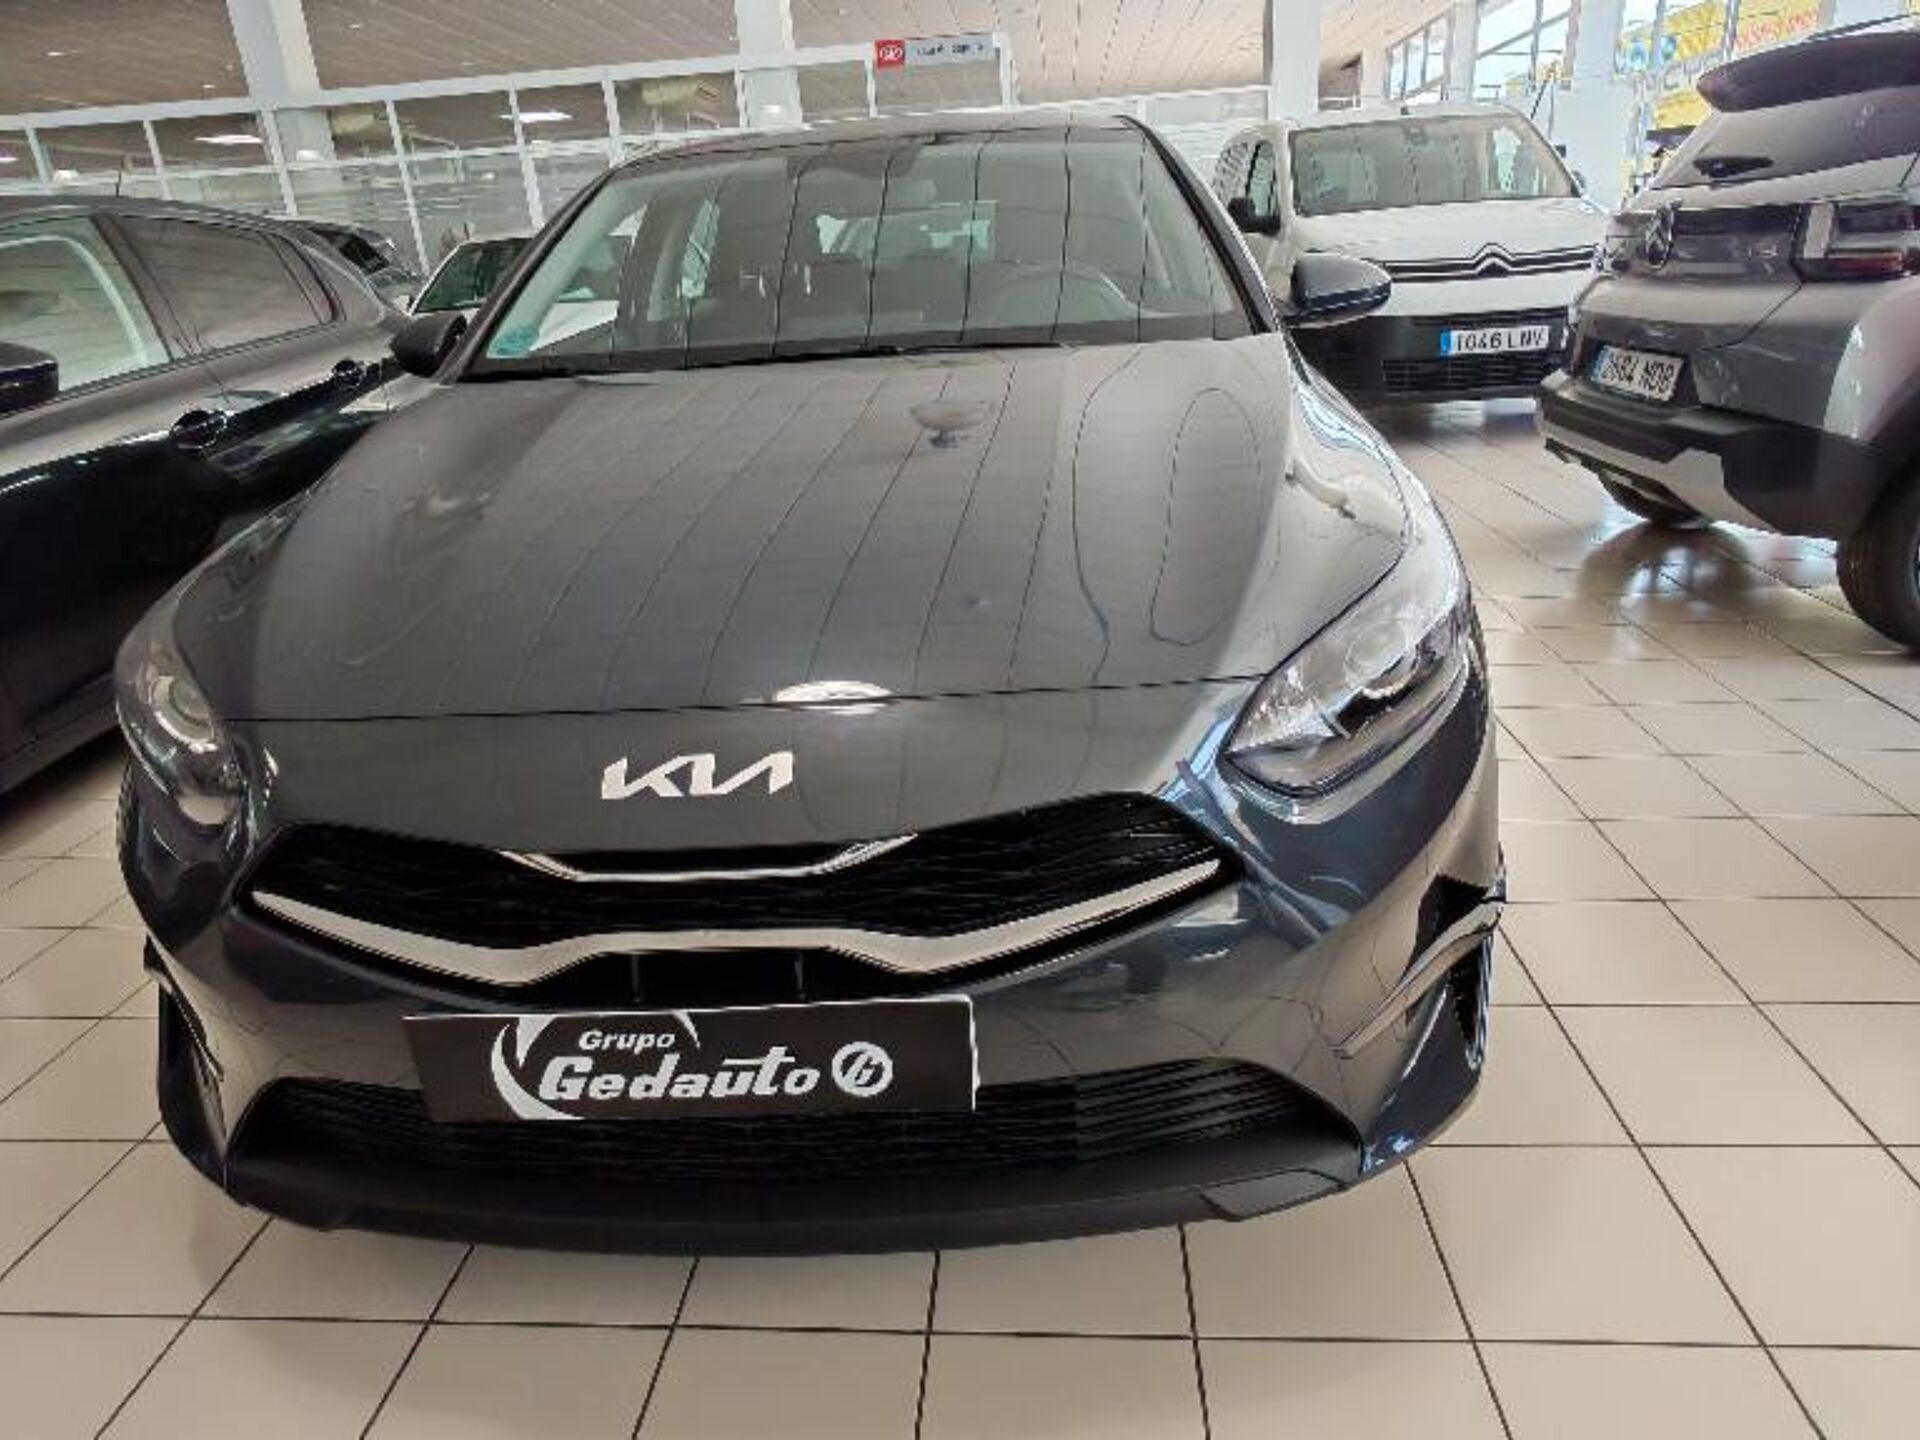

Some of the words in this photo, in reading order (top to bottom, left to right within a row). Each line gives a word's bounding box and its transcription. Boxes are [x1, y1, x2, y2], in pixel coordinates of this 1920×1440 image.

[1457, 331, 1502, 351] 1046
[578, 1029, 676, 1056] Grupo
[537, 1045, 821, 1101] Gedauto
